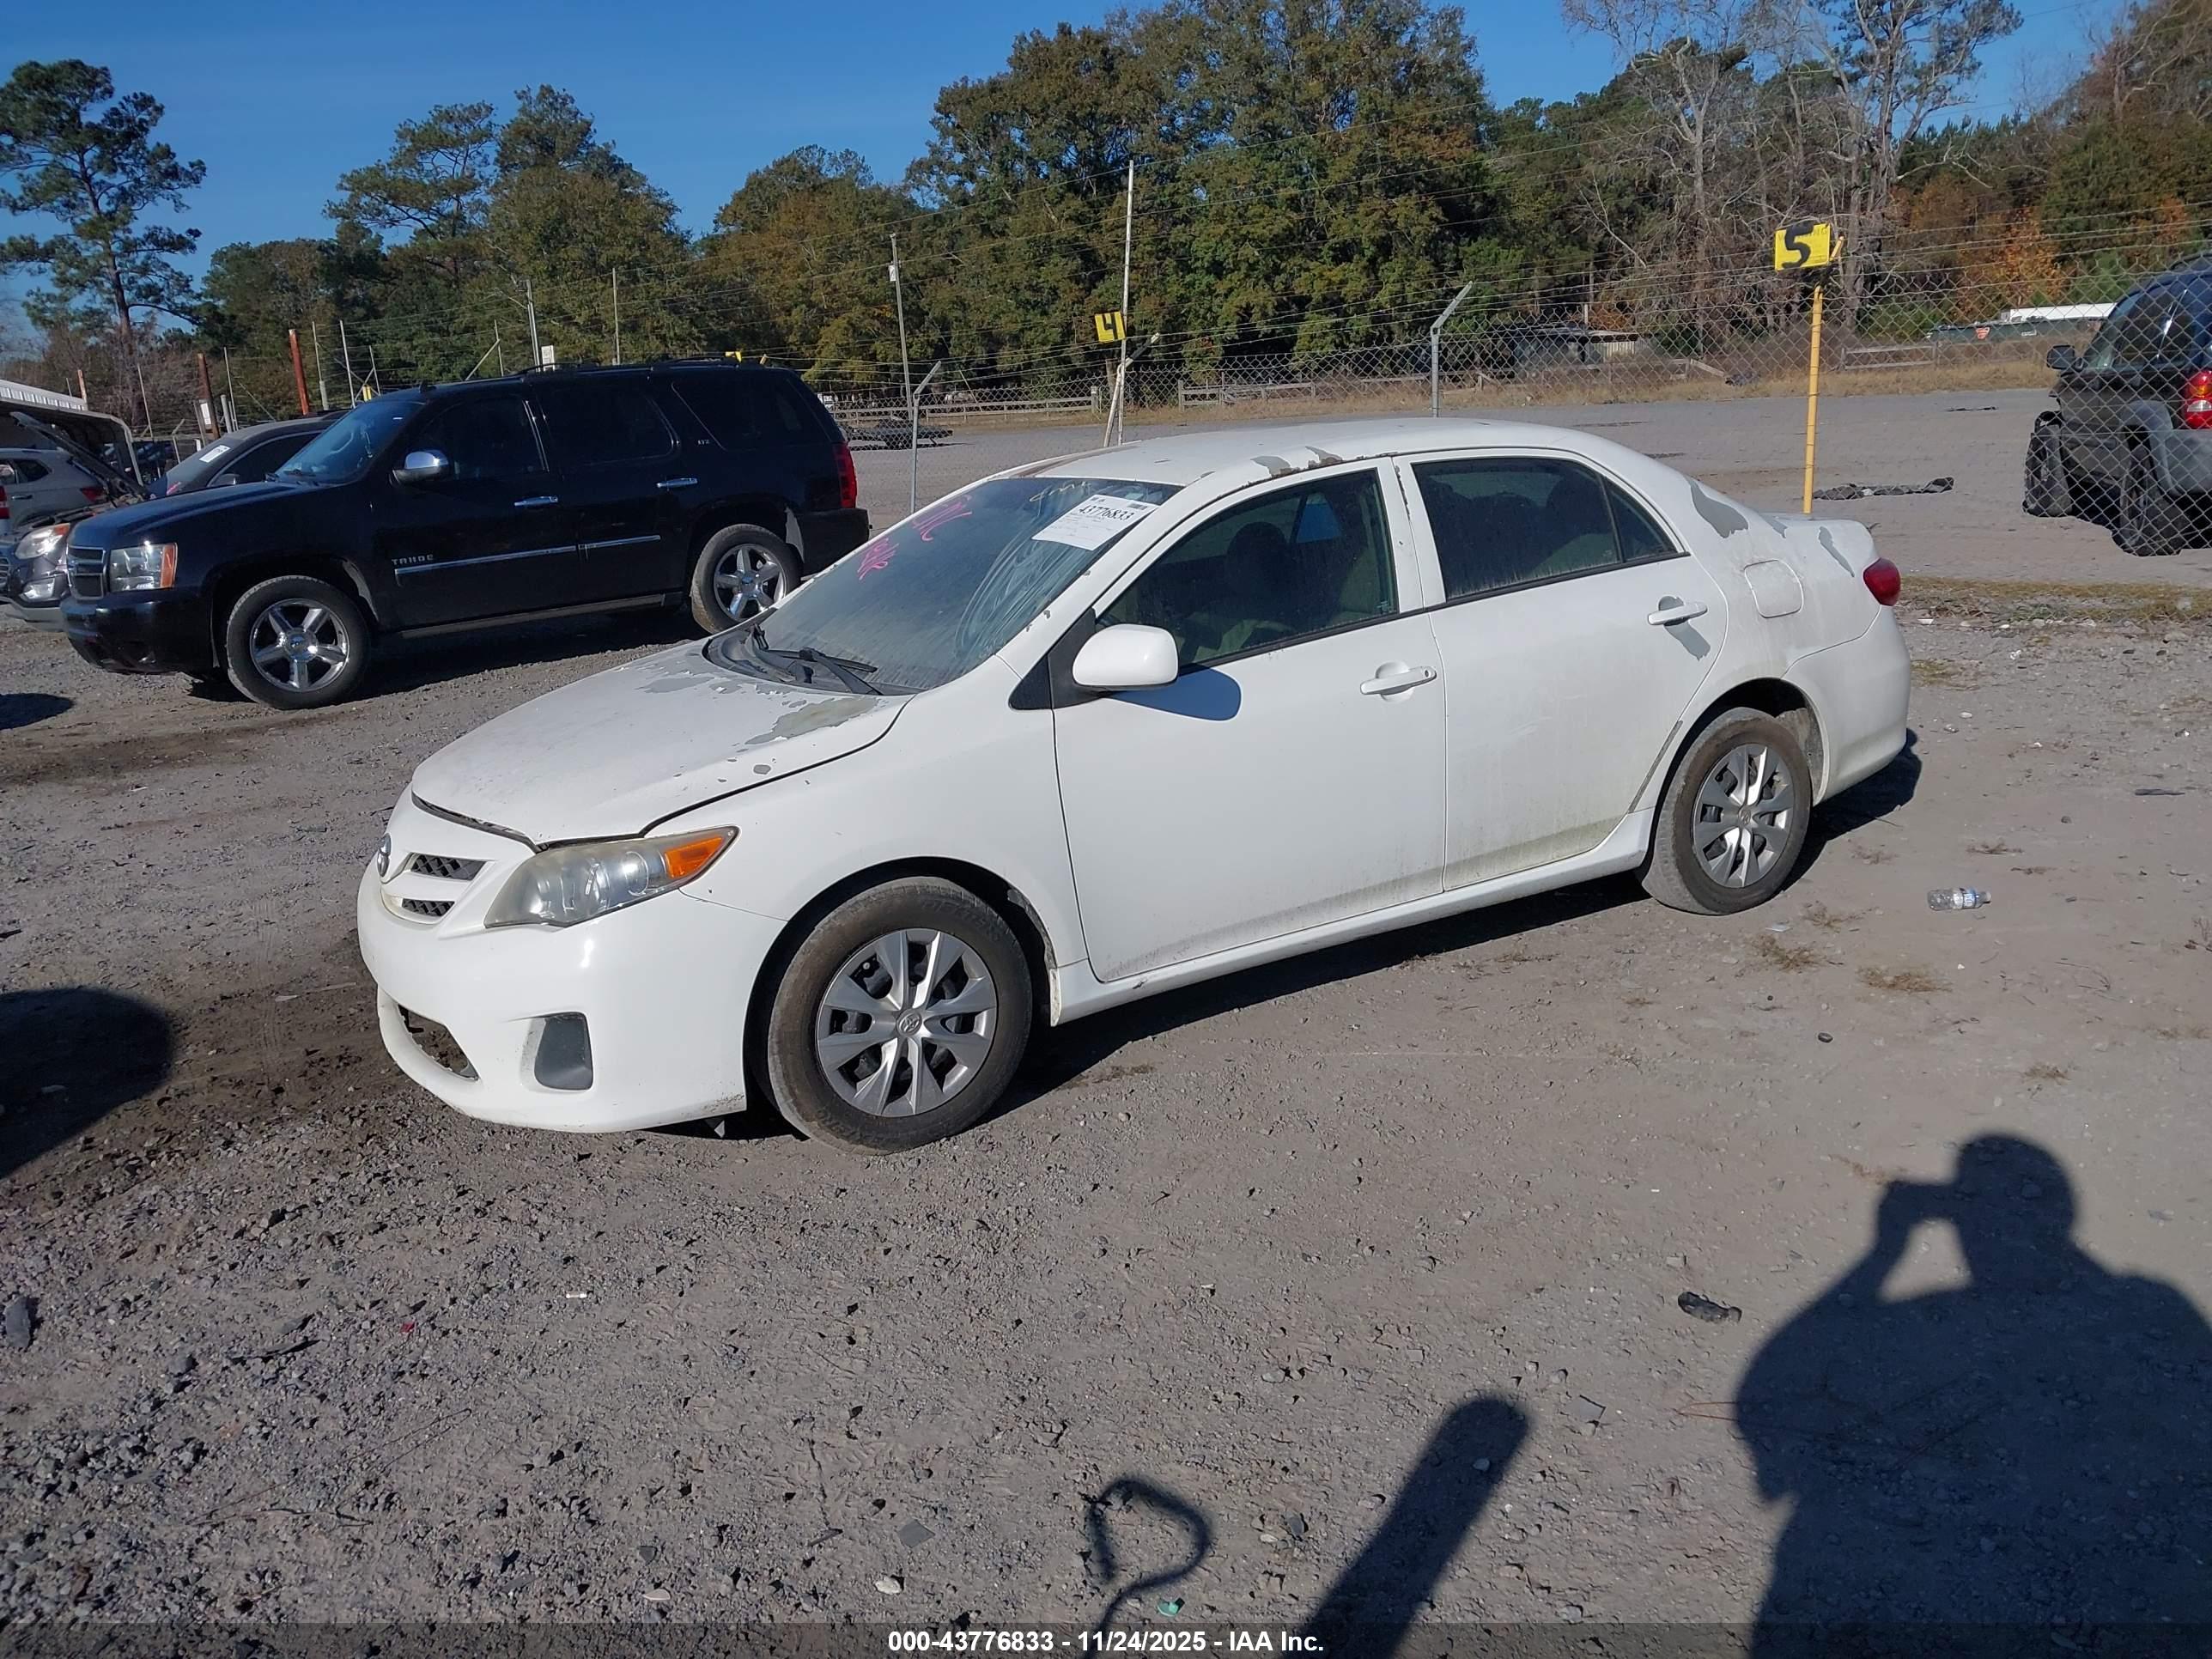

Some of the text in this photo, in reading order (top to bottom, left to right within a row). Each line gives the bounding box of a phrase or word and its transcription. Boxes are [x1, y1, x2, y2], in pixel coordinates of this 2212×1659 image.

[1782, 220, 1814, 269] 5
[1102, 313, 1119, 340] 4
[1079, 504, 1135, 520] 43776833
[391, 554, 434, 566] TAHOE
